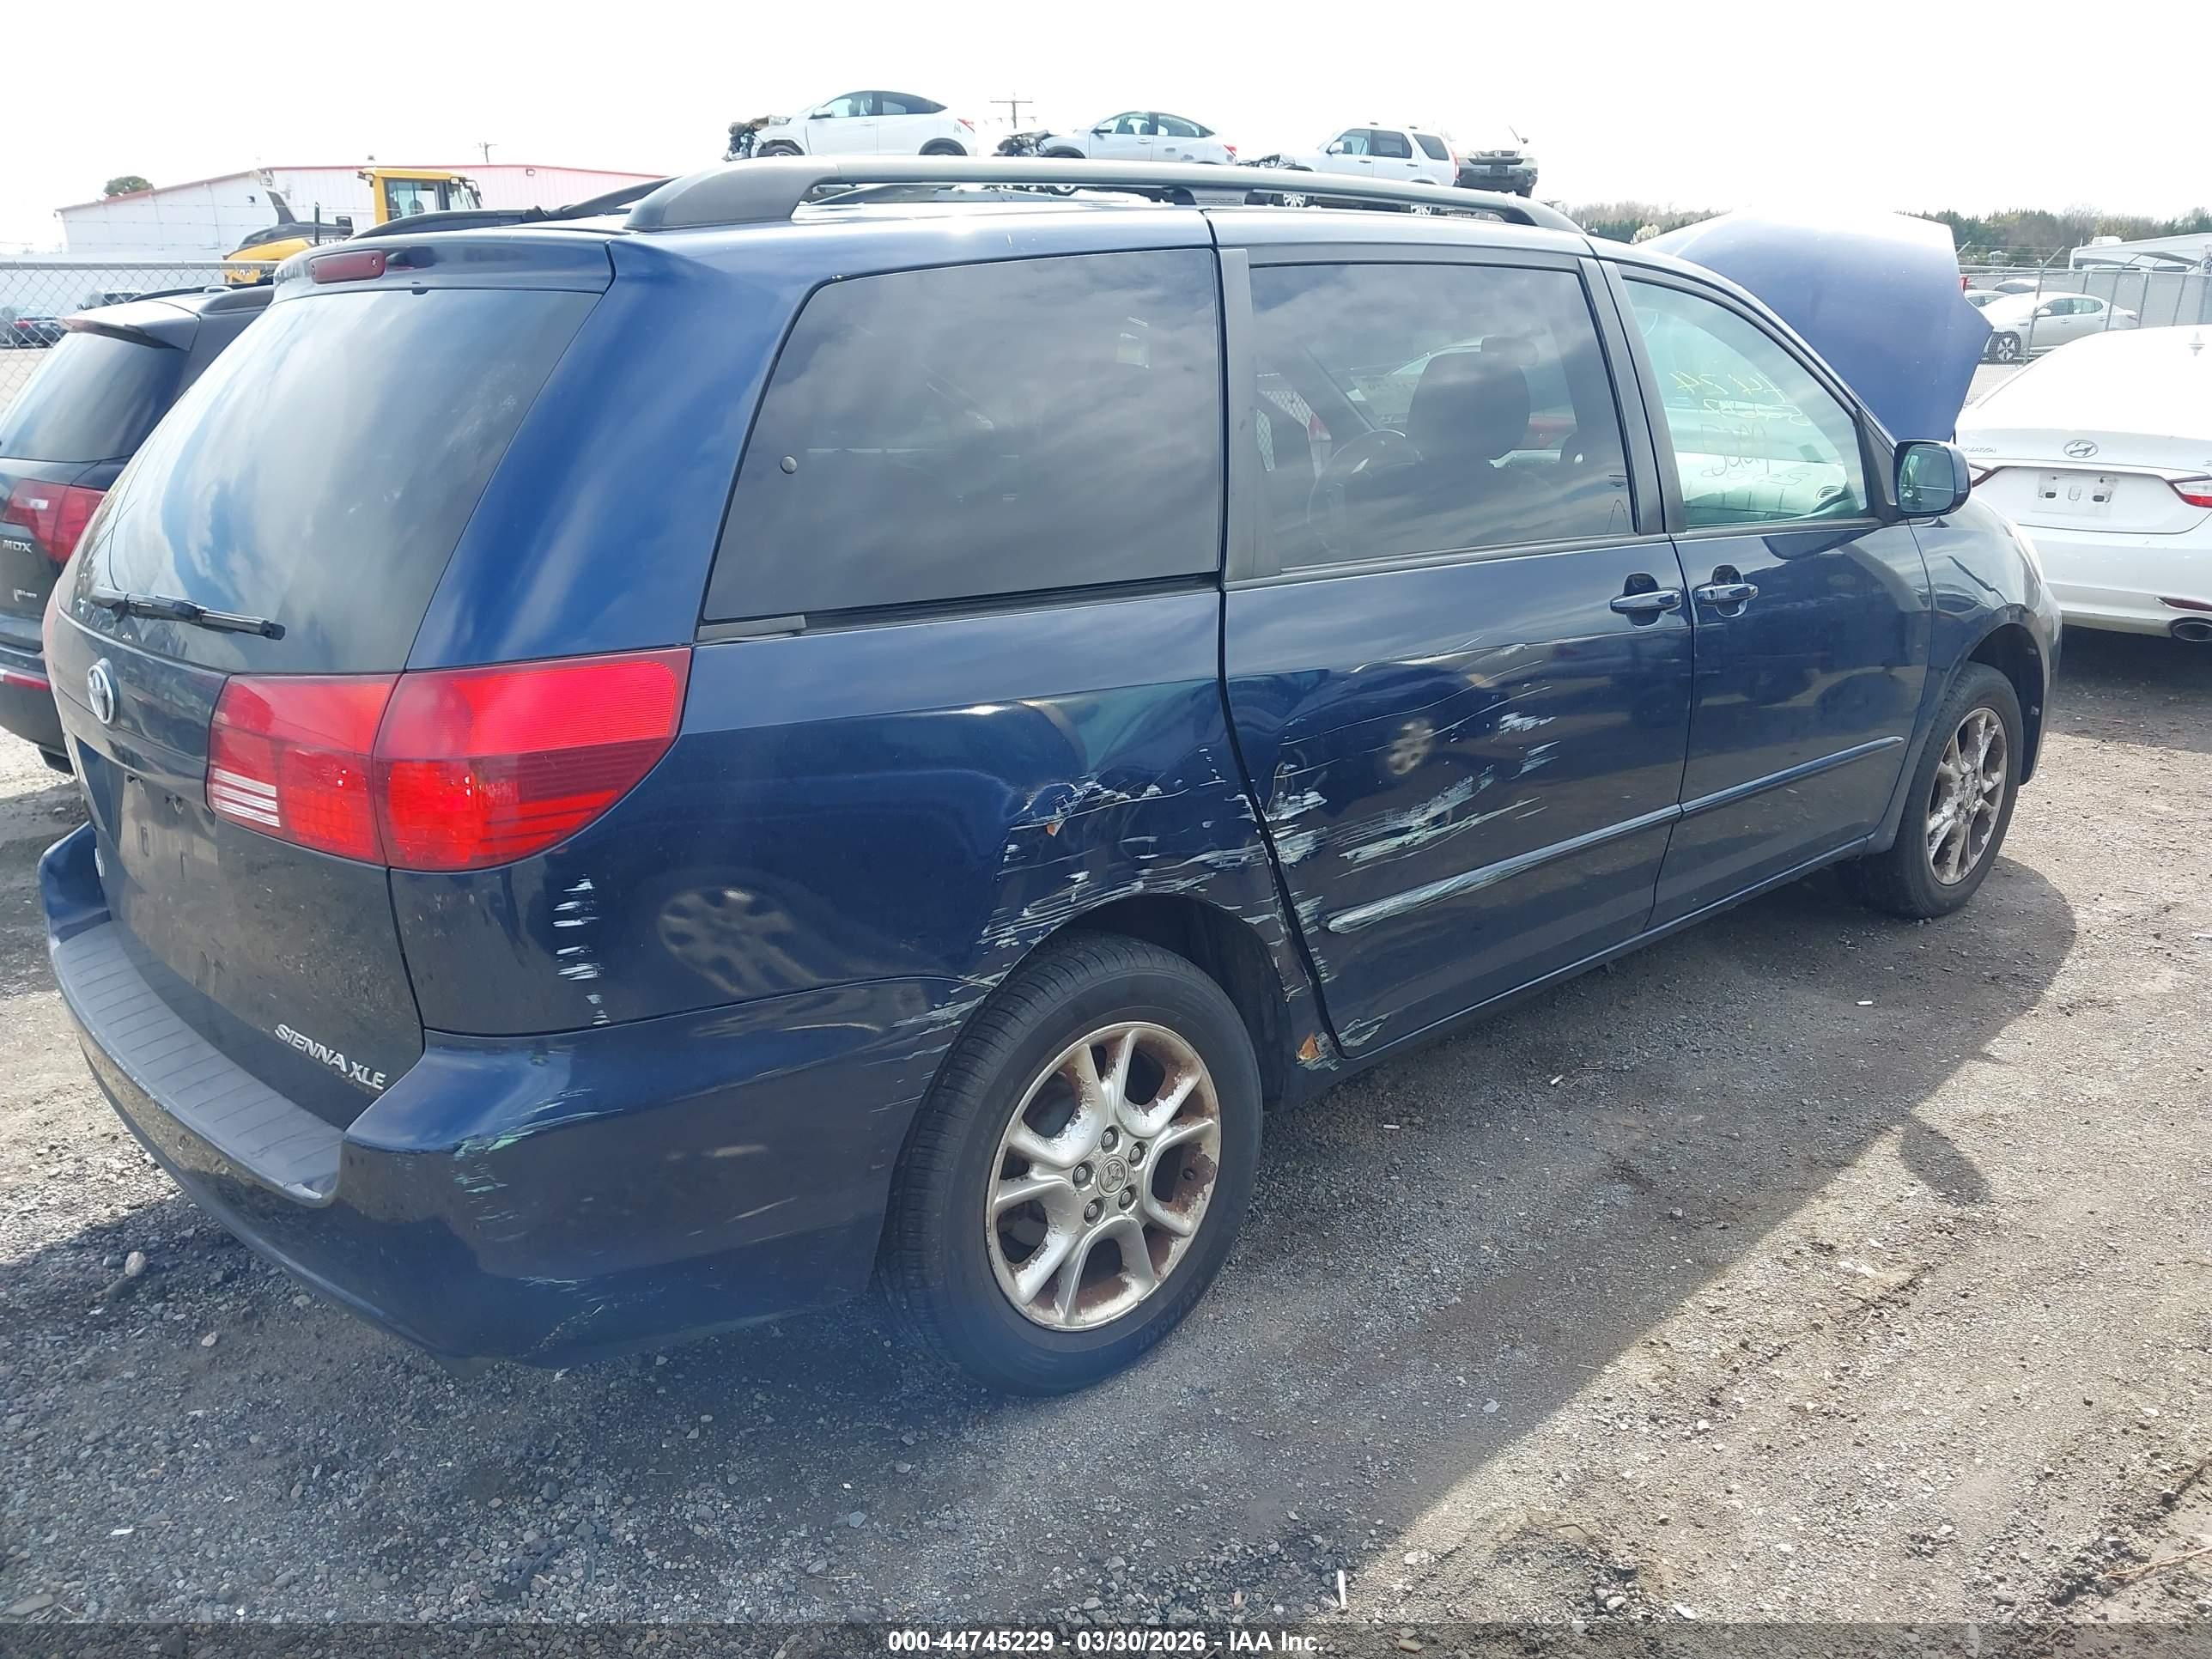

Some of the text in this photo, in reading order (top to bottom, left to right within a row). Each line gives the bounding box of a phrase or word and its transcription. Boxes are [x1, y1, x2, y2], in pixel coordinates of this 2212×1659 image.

[3, 539, 33, 555] MDX
[274, 1024, 386, 1091] SIENNA XLE
